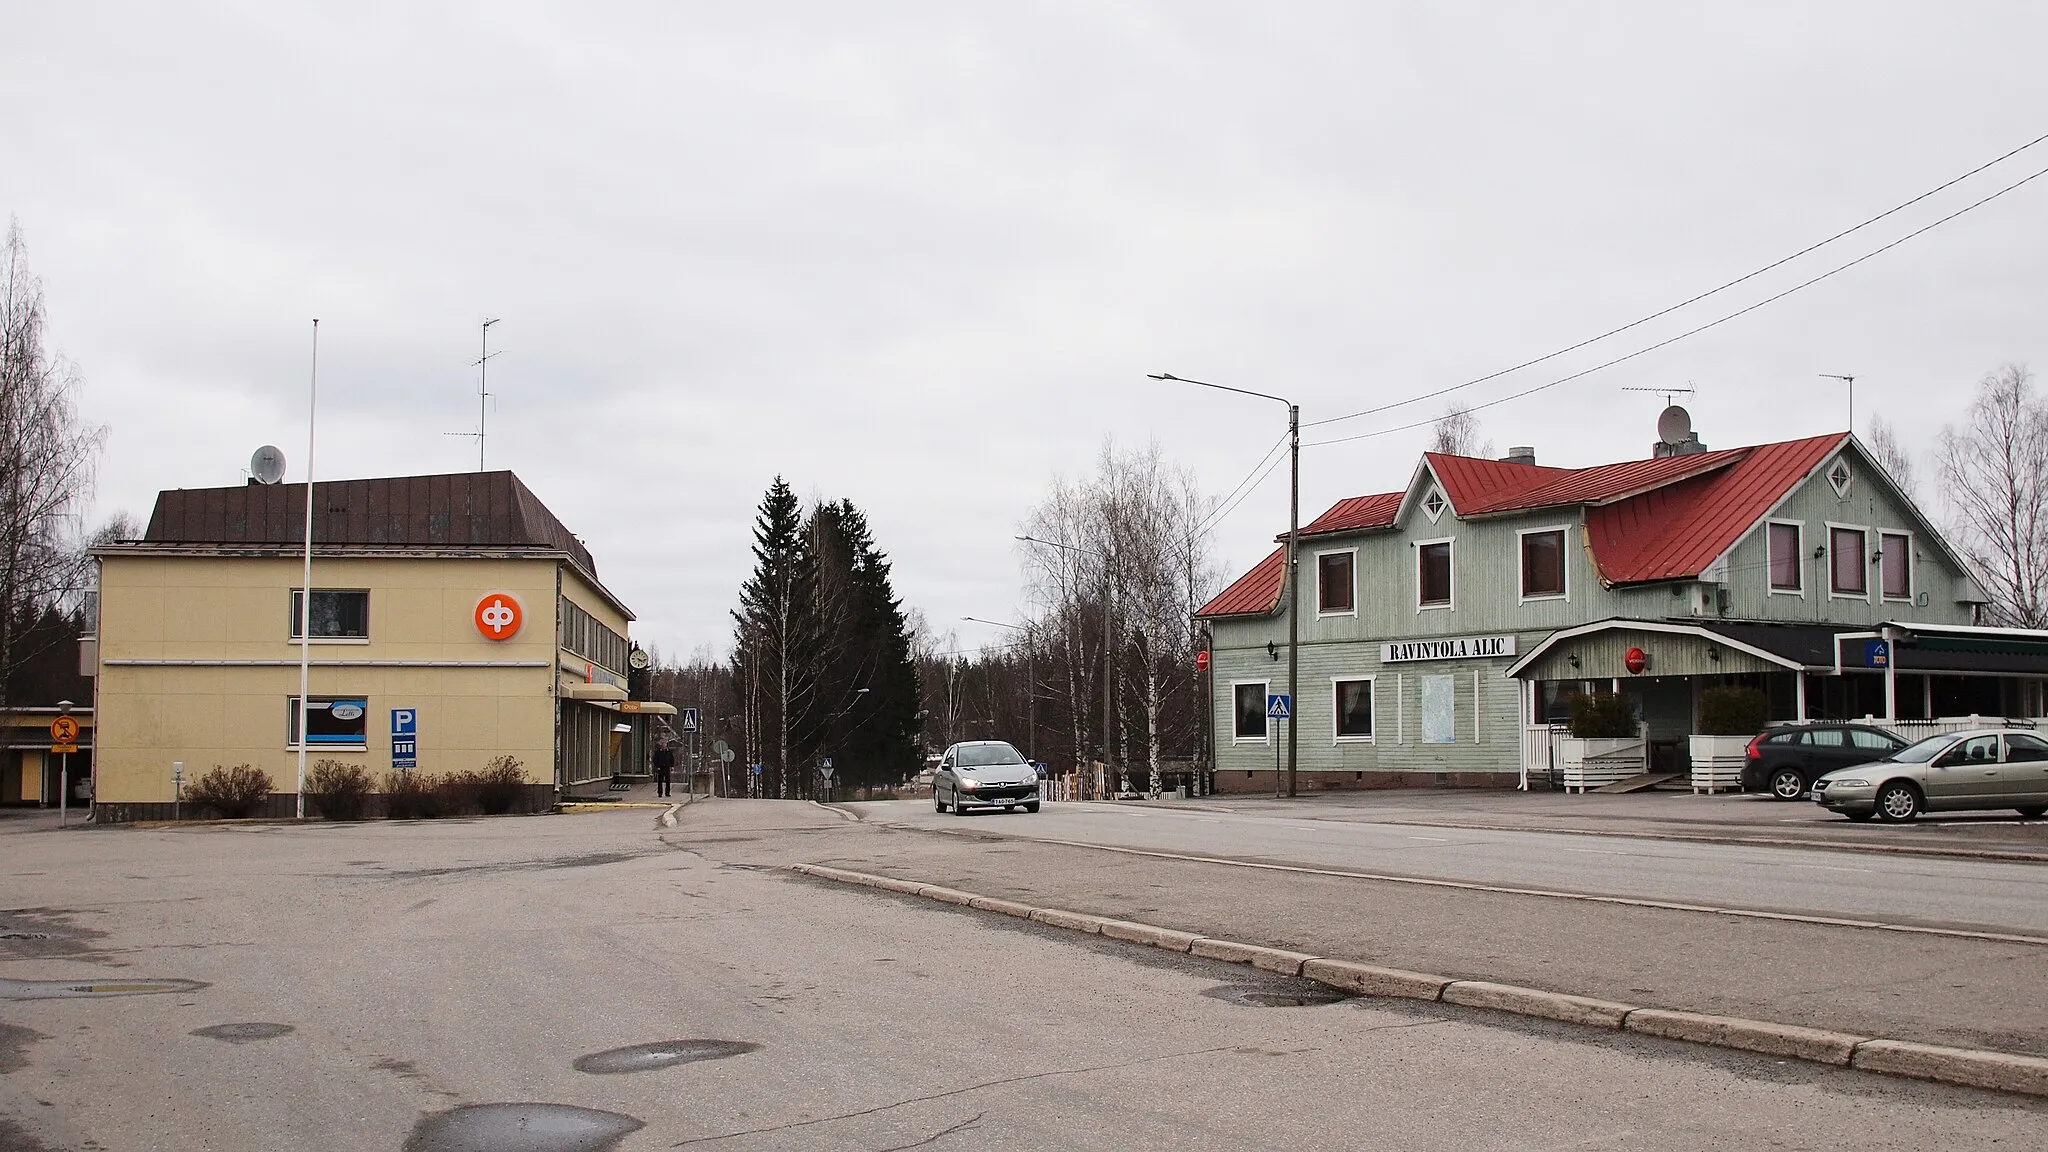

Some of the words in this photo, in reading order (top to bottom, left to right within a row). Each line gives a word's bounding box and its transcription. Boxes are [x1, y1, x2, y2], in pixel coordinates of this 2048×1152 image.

[1390, 640, 1467, 660] RAVINTOLA
[1472, 638, 1505, 655] ALIC
[396, 711, 412, 731] P
